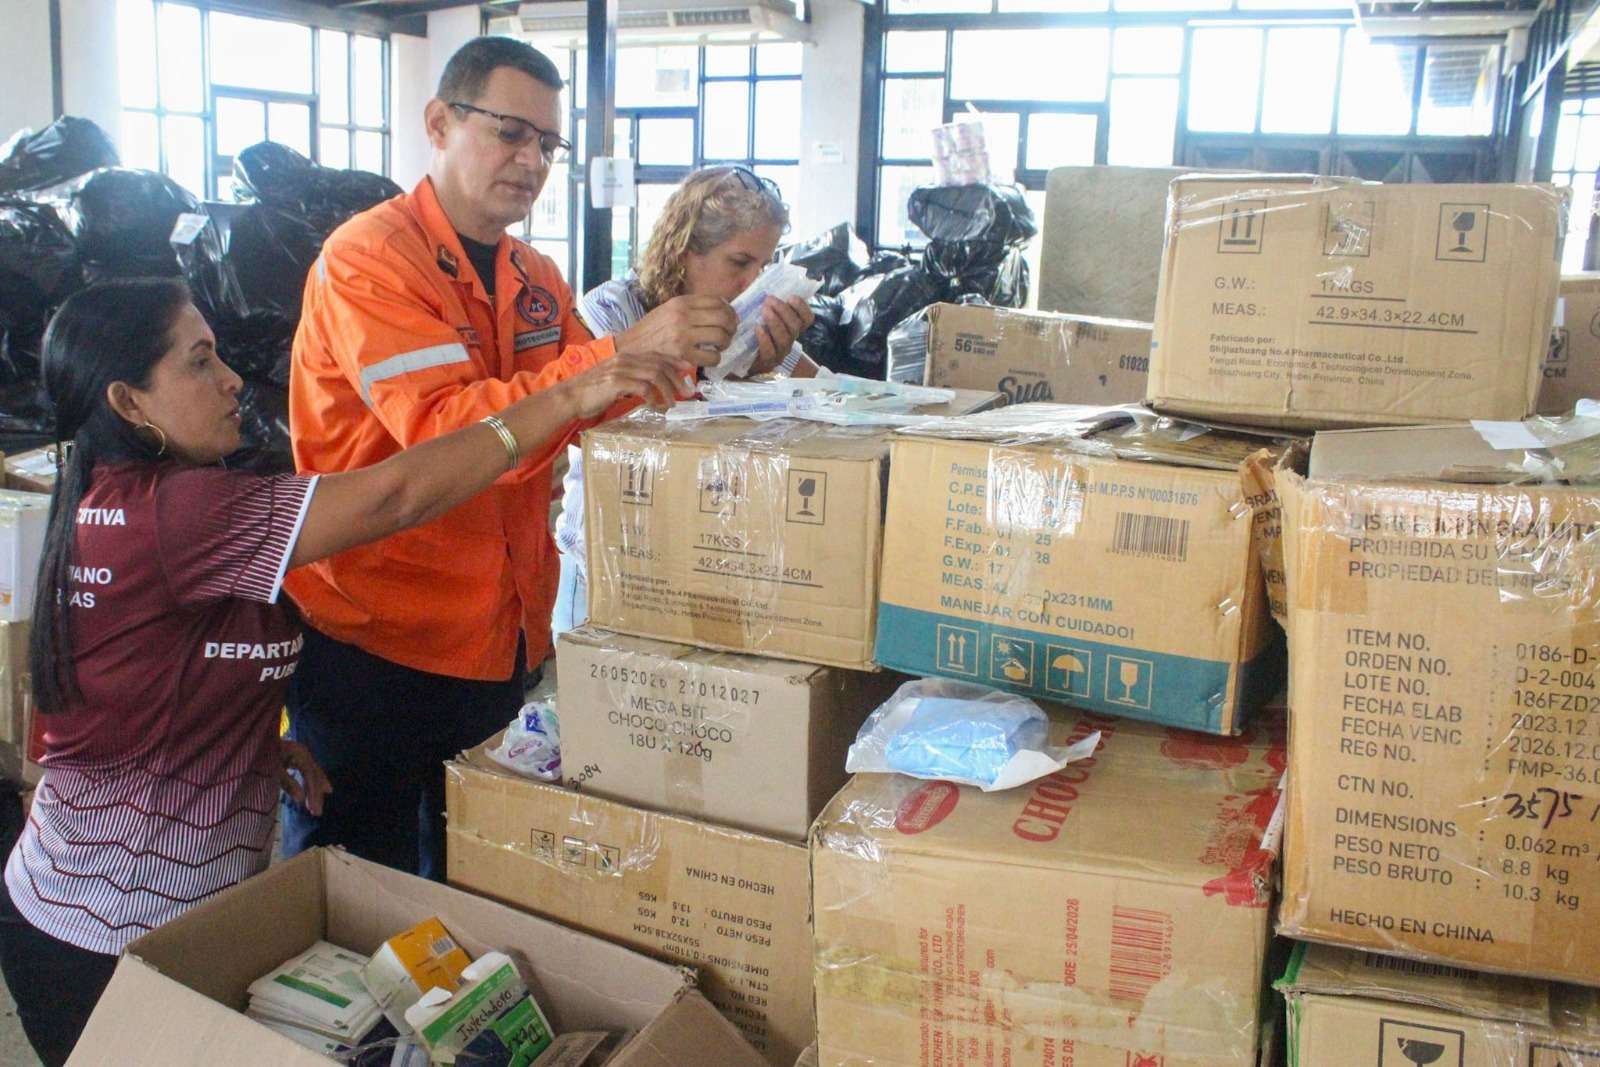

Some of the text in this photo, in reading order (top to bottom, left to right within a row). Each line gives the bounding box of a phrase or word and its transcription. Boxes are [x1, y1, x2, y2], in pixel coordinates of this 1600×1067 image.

[1214, 276, 1255, 290] G.W.:
[1212, 302, 1266, 316] MEAS.:
[954, 338, 973, 353] 56
[946, 498, 982, 515] Lote:
[1349, 537, 1456, 559] PROHIBIDA
[1461, 543, 1488, 560] SU
[1348, 560, 1459, 584] PROPIEDAD
[940, 595, 1013, 619] MANEJAR
[1017, 608, 1050, 625] CON
[1346, 628, 1391, 649] ITEM
[1396, 632, 1430, 653] NO.
[1345, 650, 1412, 673] ORDEN
[1418, 657, 1452, 677] NO.
[1344, 672, 1392, 693] LOTE
[1396, 677, 1431, 697] NO.
[1342, 694, 1406, 718] FECHA
[1412, 702, 1463, 724] ELAB
[608, 710, 667, 733] CHOCO
[1341, 716, 1404, 740] FECHA
[1409, 724, 1463, 746] VENC
[628, 733, 657, 750] 18U
[1340, 737, 1379, 758] REG
[1383, 743, 1417, 763] NO.
[1337, 774, 1415, 799] CTN NO.
[1335, 807, 1457, 838] DIMENSIONS
[1504, 834, 1557, 855] 0.062
[1334, 834, 1570, 885] PESO NETO 8.8 kg
[685, 866, 775, 896] HECHO EN CHINA
[1333, 856, 1580, 911] PESO BRUTO 10.3 kg
[637, 907, 657, 920] KGS
[711, 908, 744, 924] BRUTO
[745, 917, 773, 931] PESO
[716, 926, 743, 939] NETO
[1329, 908, 1495, 945] HECHO EN CHINA
[744, 934, 772, 947] PESO
[932, 935, 943, 954] LTD
